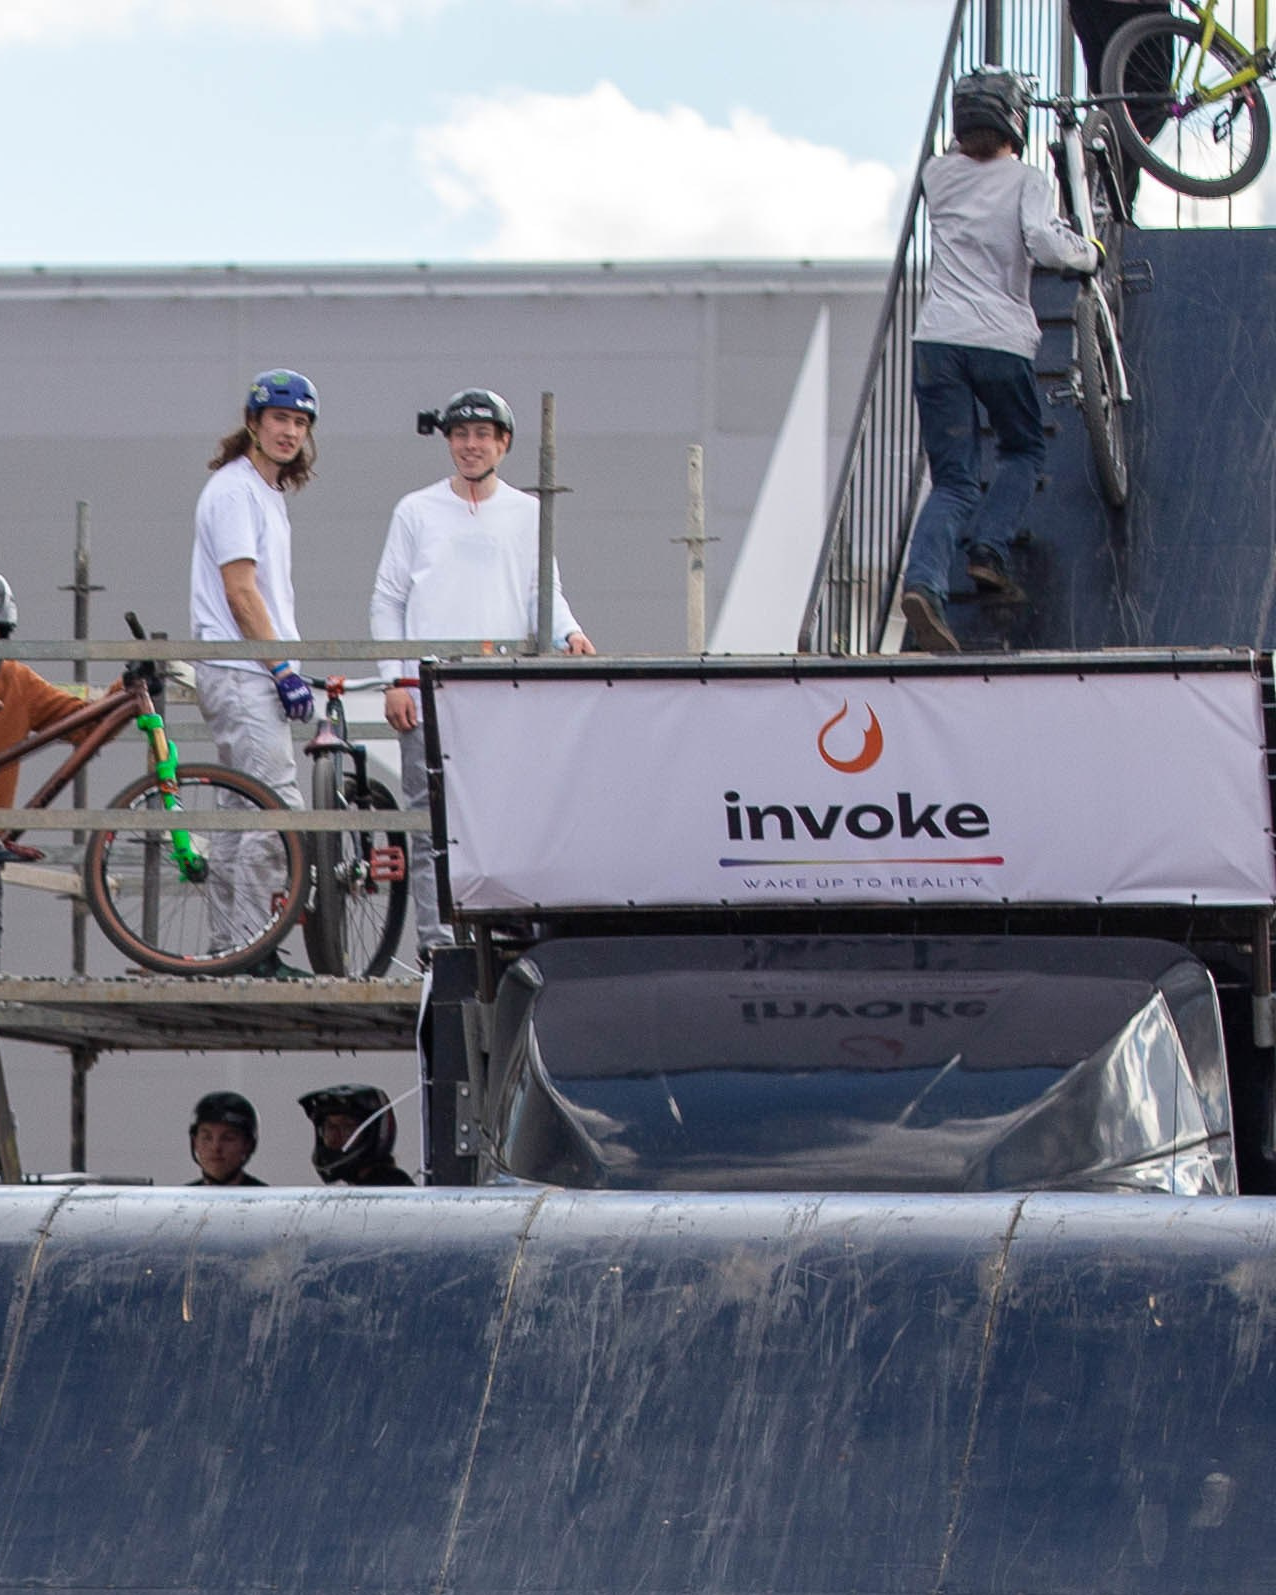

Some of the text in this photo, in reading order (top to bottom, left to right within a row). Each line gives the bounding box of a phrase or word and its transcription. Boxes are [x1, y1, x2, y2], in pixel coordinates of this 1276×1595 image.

[724, 790, 991, 841] invoke
[742, 876, 983, 889] WAKE UP TO REALITY
